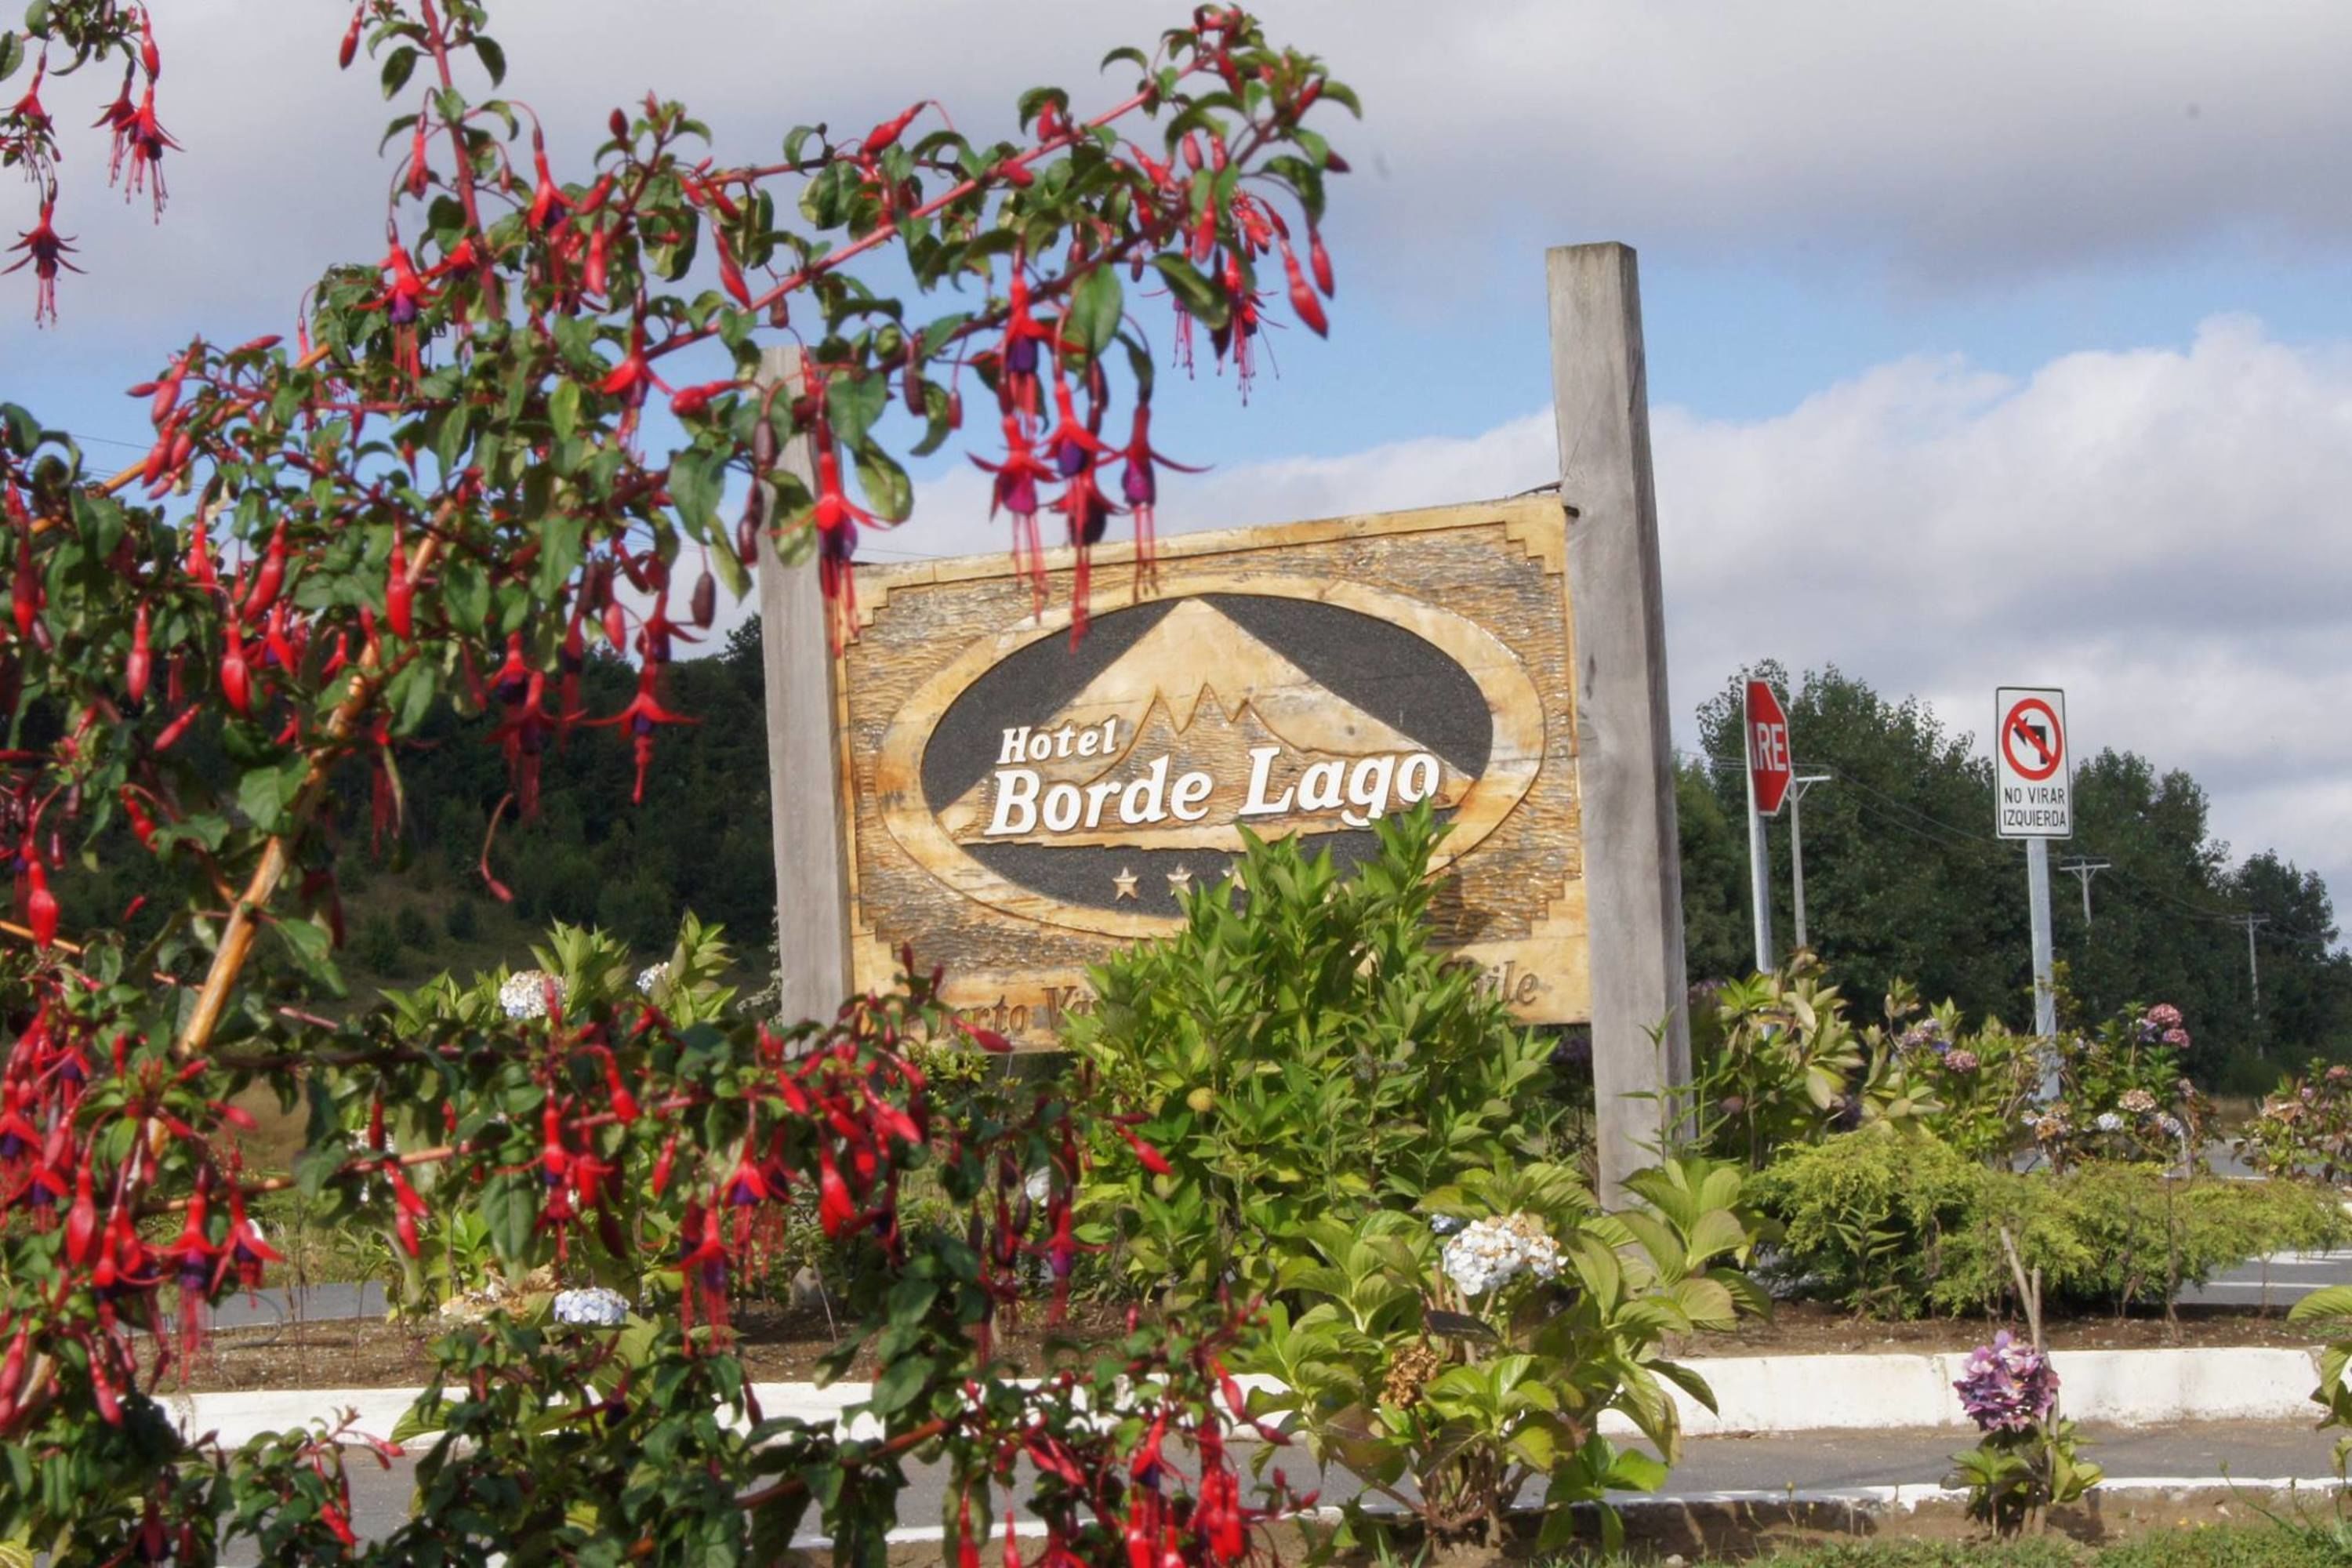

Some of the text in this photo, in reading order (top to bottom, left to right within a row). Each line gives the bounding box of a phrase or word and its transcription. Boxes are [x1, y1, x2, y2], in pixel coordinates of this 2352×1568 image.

[995, 719, 1118, 764] Hotel
[983, 746, 1440, 836] Borde Lago
[2004, 786, 2065, 804] NO VIRAR
[2003, 809, 2067, 827] IZQUIERDA
